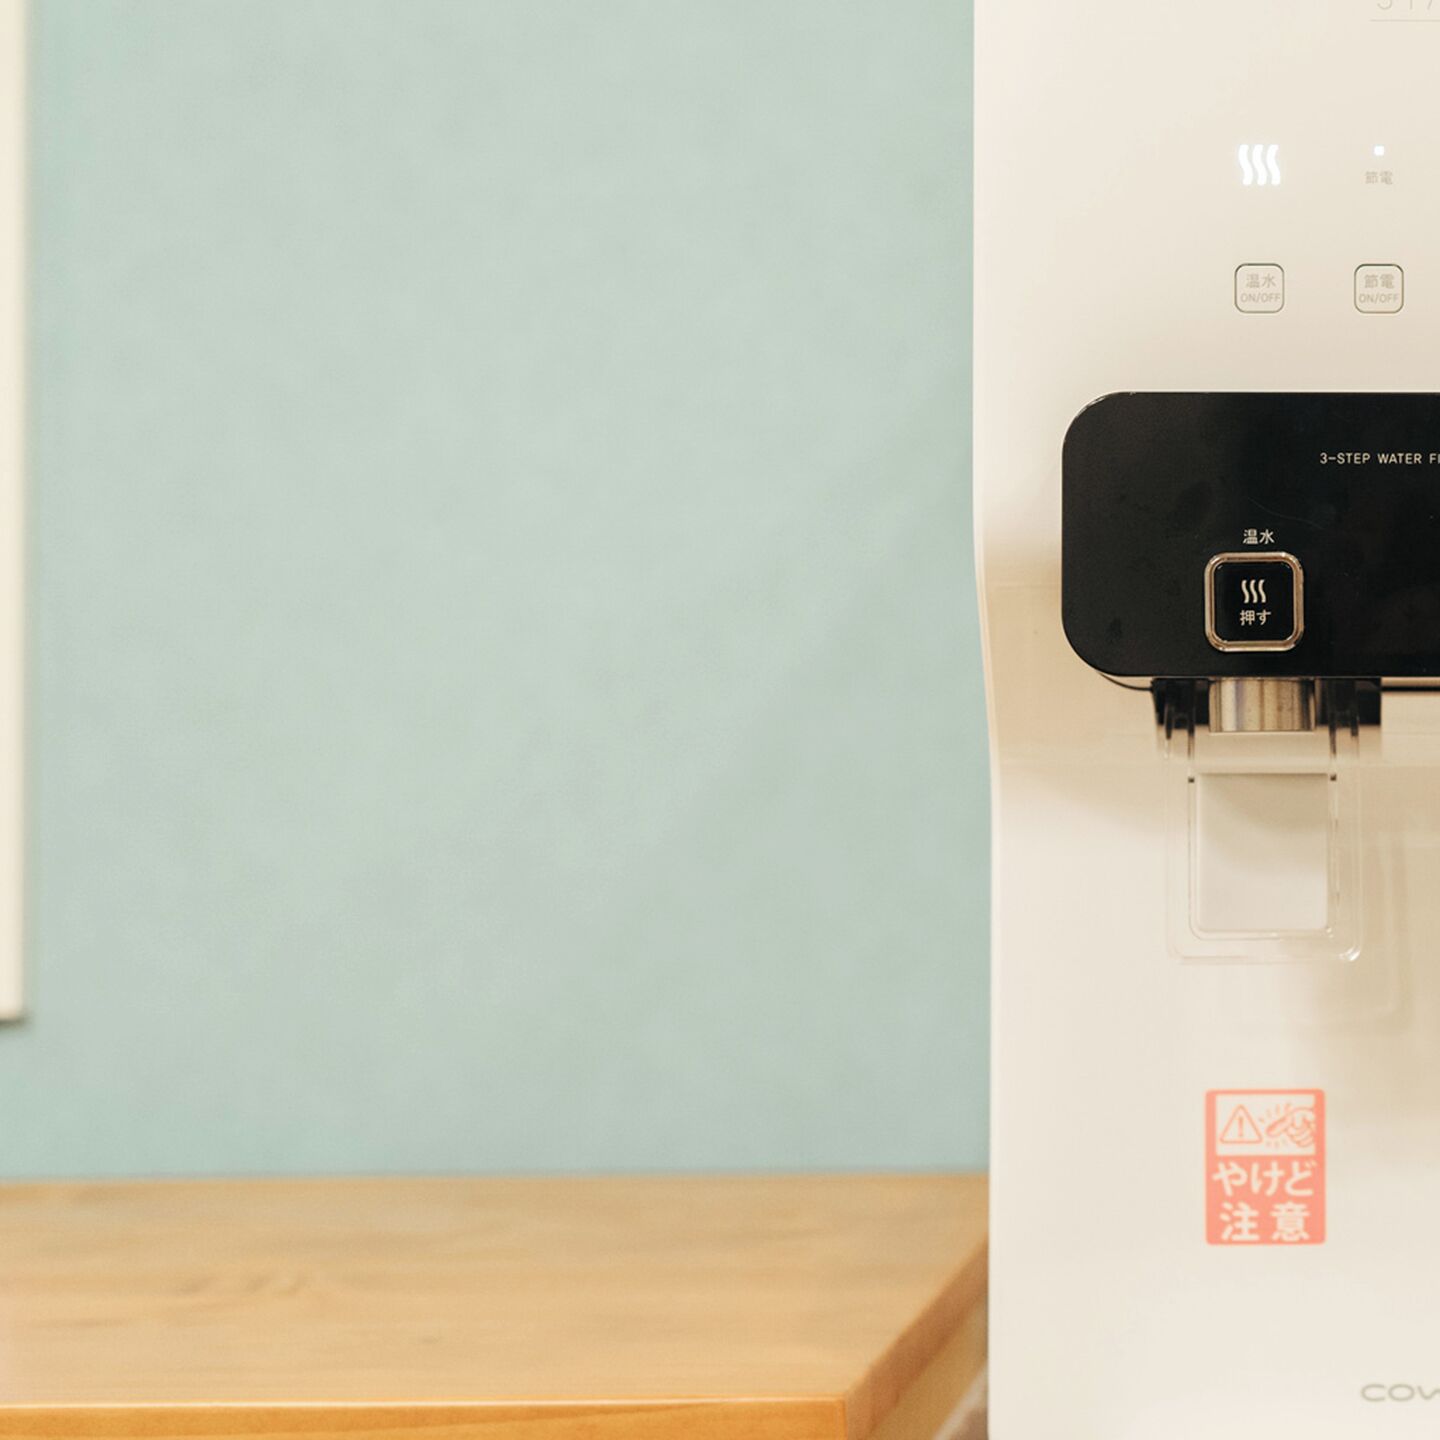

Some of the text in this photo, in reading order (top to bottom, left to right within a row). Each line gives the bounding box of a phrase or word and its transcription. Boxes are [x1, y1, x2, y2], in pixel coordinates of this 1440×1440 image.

[1365, 171, 1393, 185] 節電
[1246, 274, 1276, 289] 温水
[1364, 274, 1395, 289] 節電
[1240, 293, 1281, 303] ON/OFF
[1358, 294, 1399, 304] ON/OFF
[1320, 453, 1370, 464] 3-STEP
[1378, 453, 1422, 464] WATER
[1243, 529, 1274, 545] 温水
[1240, 609, 1271, 625] 押す
[1213, 1160, 1316, 1197] やけど
[1220, 1201, 1310, 1241] 注意
